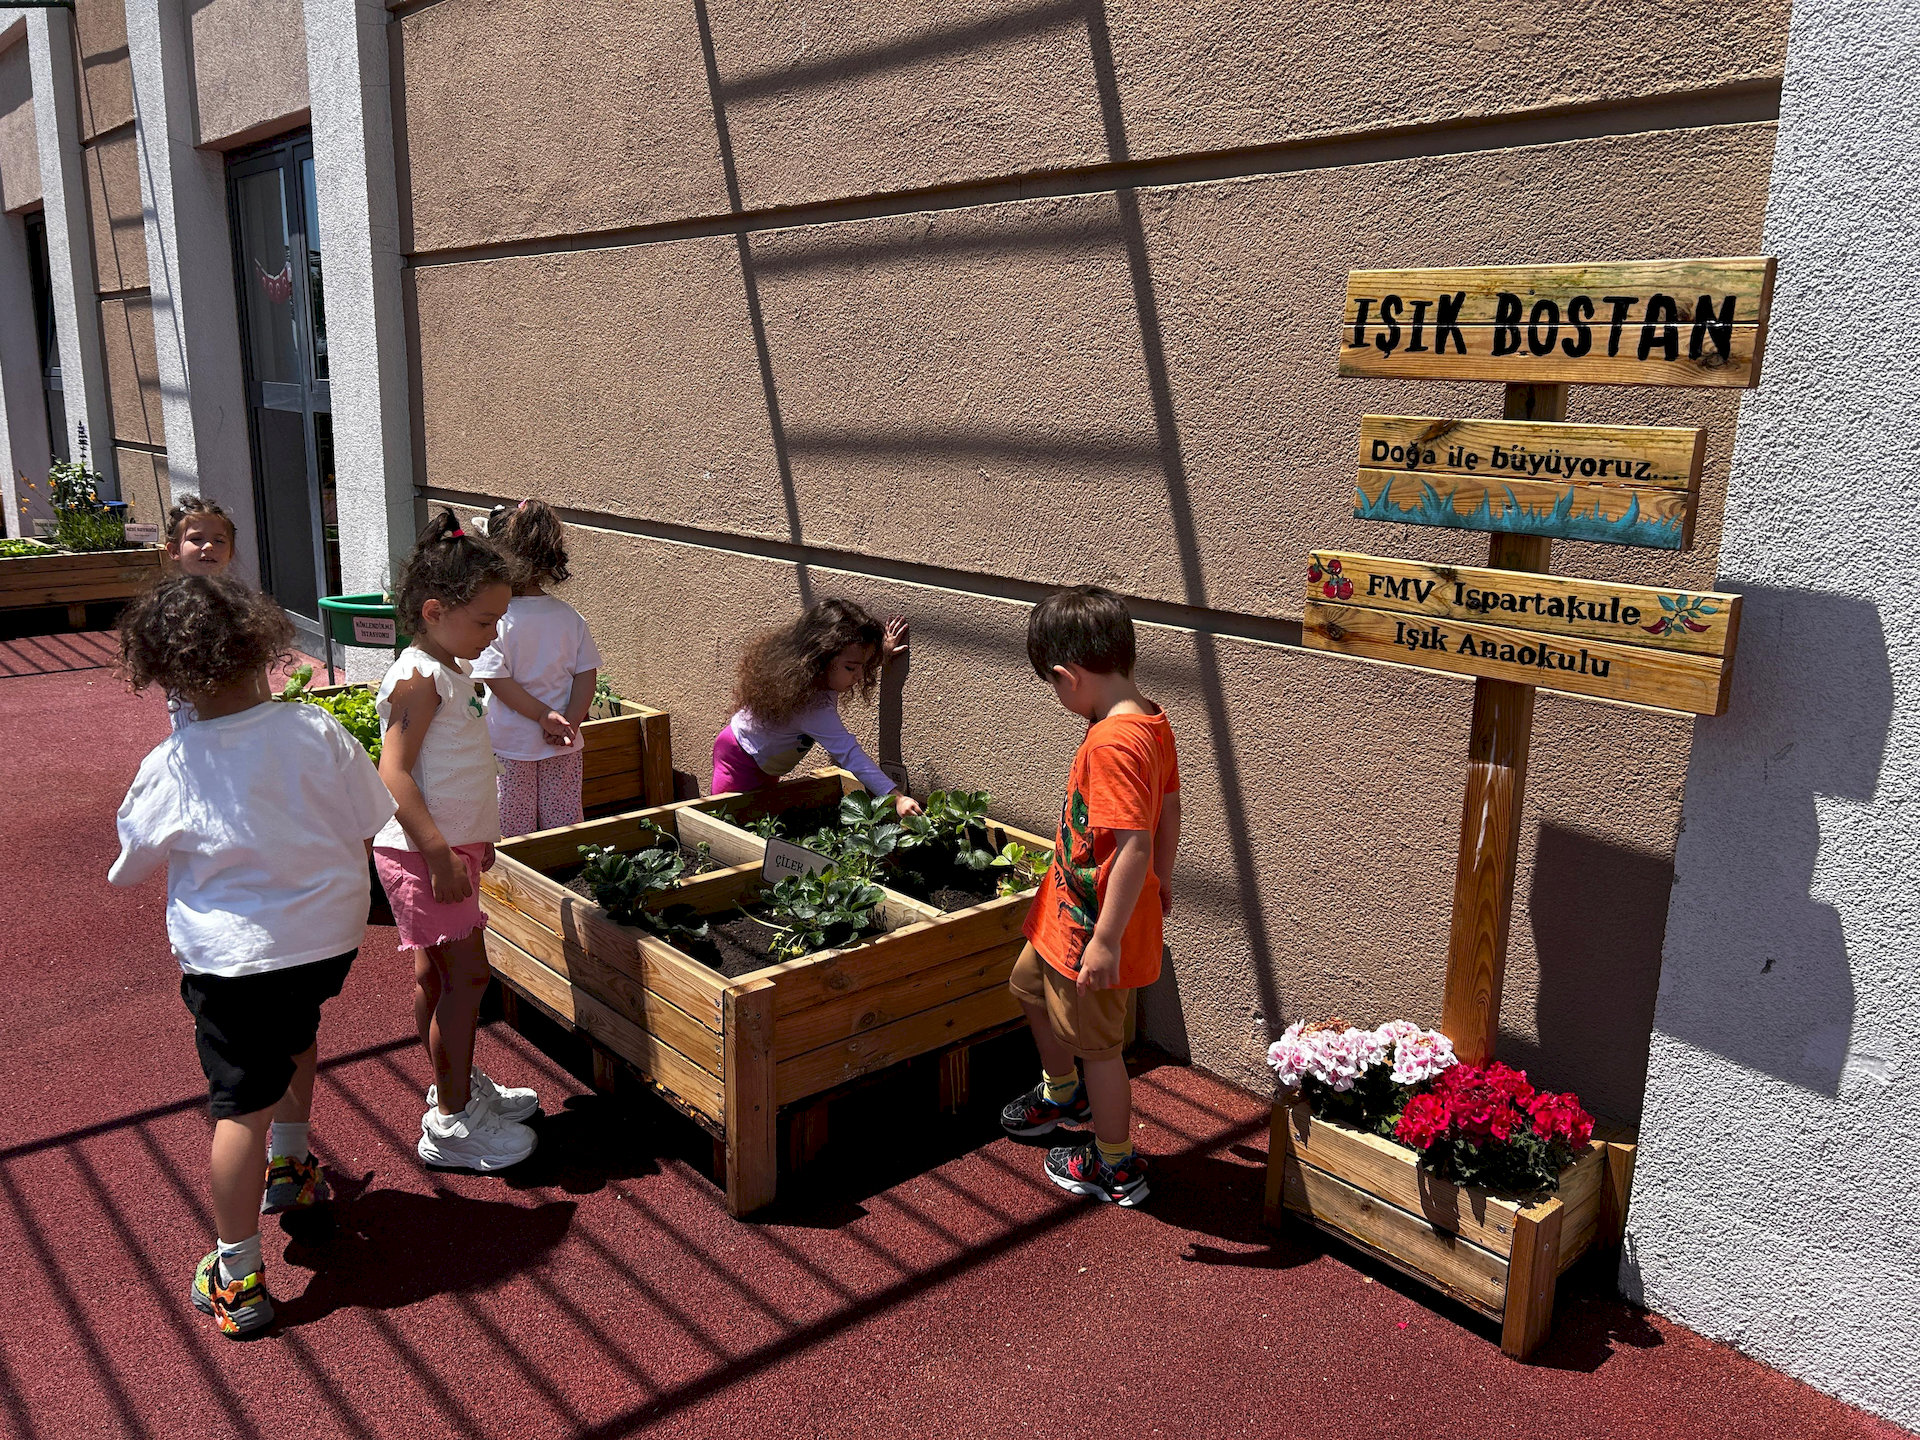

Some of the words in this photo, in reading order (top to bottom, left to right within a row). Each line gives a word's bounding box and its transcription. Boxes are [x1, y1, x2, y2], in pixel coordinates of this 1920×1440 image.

[1349, 291, 1467, 359] IŞIK
[1491, 292, 1737, 361] BOSTAN
[1371, 439, 1436, 470] Doğa
[1448, 445, 1479, 471] ile
[1366, 573, 1436, 604] FMV
[1452, 582, 1641, 625] Ispartakule
[1394, 621, 1448, 651] Işık
[1456, 633, 1611, 678] Anaokulu
[776, 854, 803, 873] ÇİLEK
